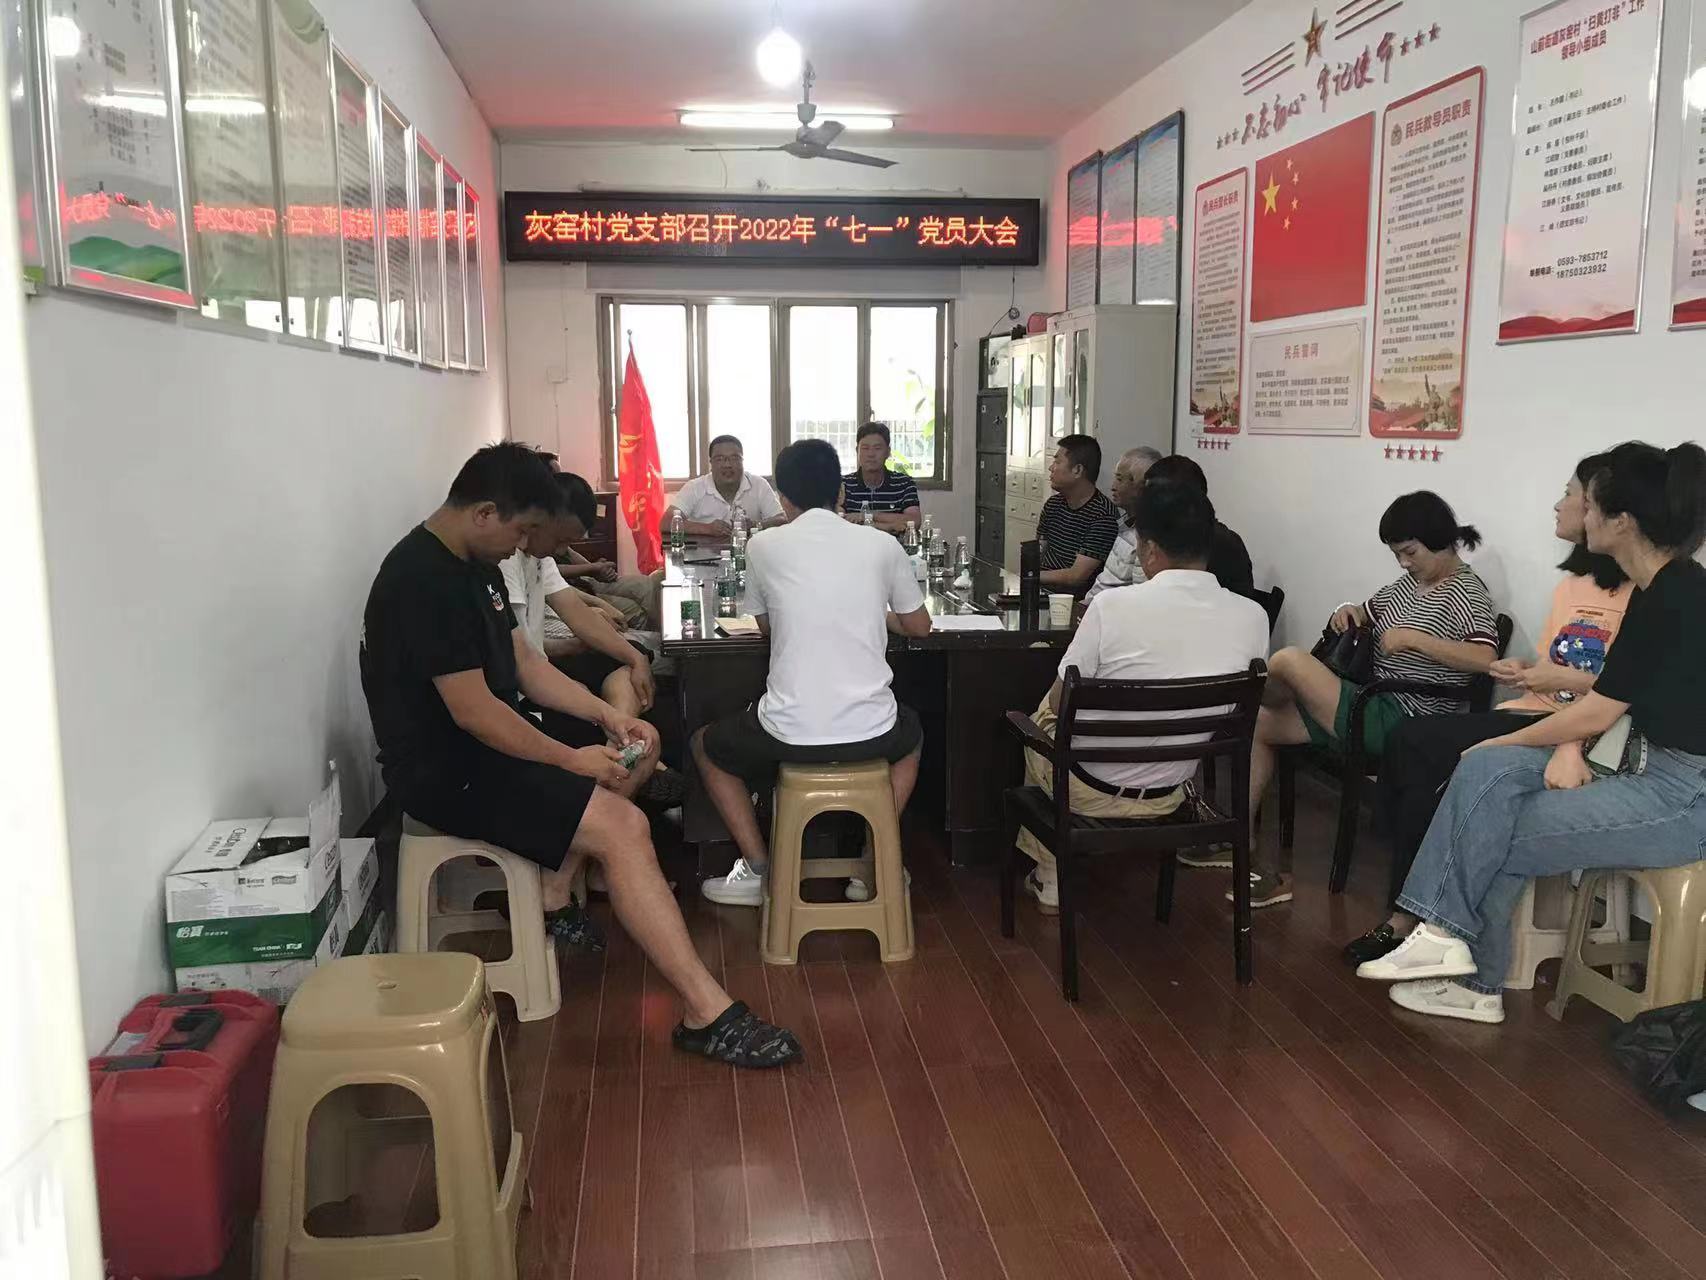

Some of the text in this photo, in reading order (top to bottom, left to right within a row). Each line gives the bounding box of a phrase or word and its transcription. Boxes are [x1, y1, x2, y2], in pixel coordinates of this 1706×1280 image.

[525, 210, 1020, 246] 灰窑村党支部召开2022年“七一”党员大会
[1557, 250, 1608, 267] 0593-7853712
[1557, 263, 1607, 279] 18750323932
